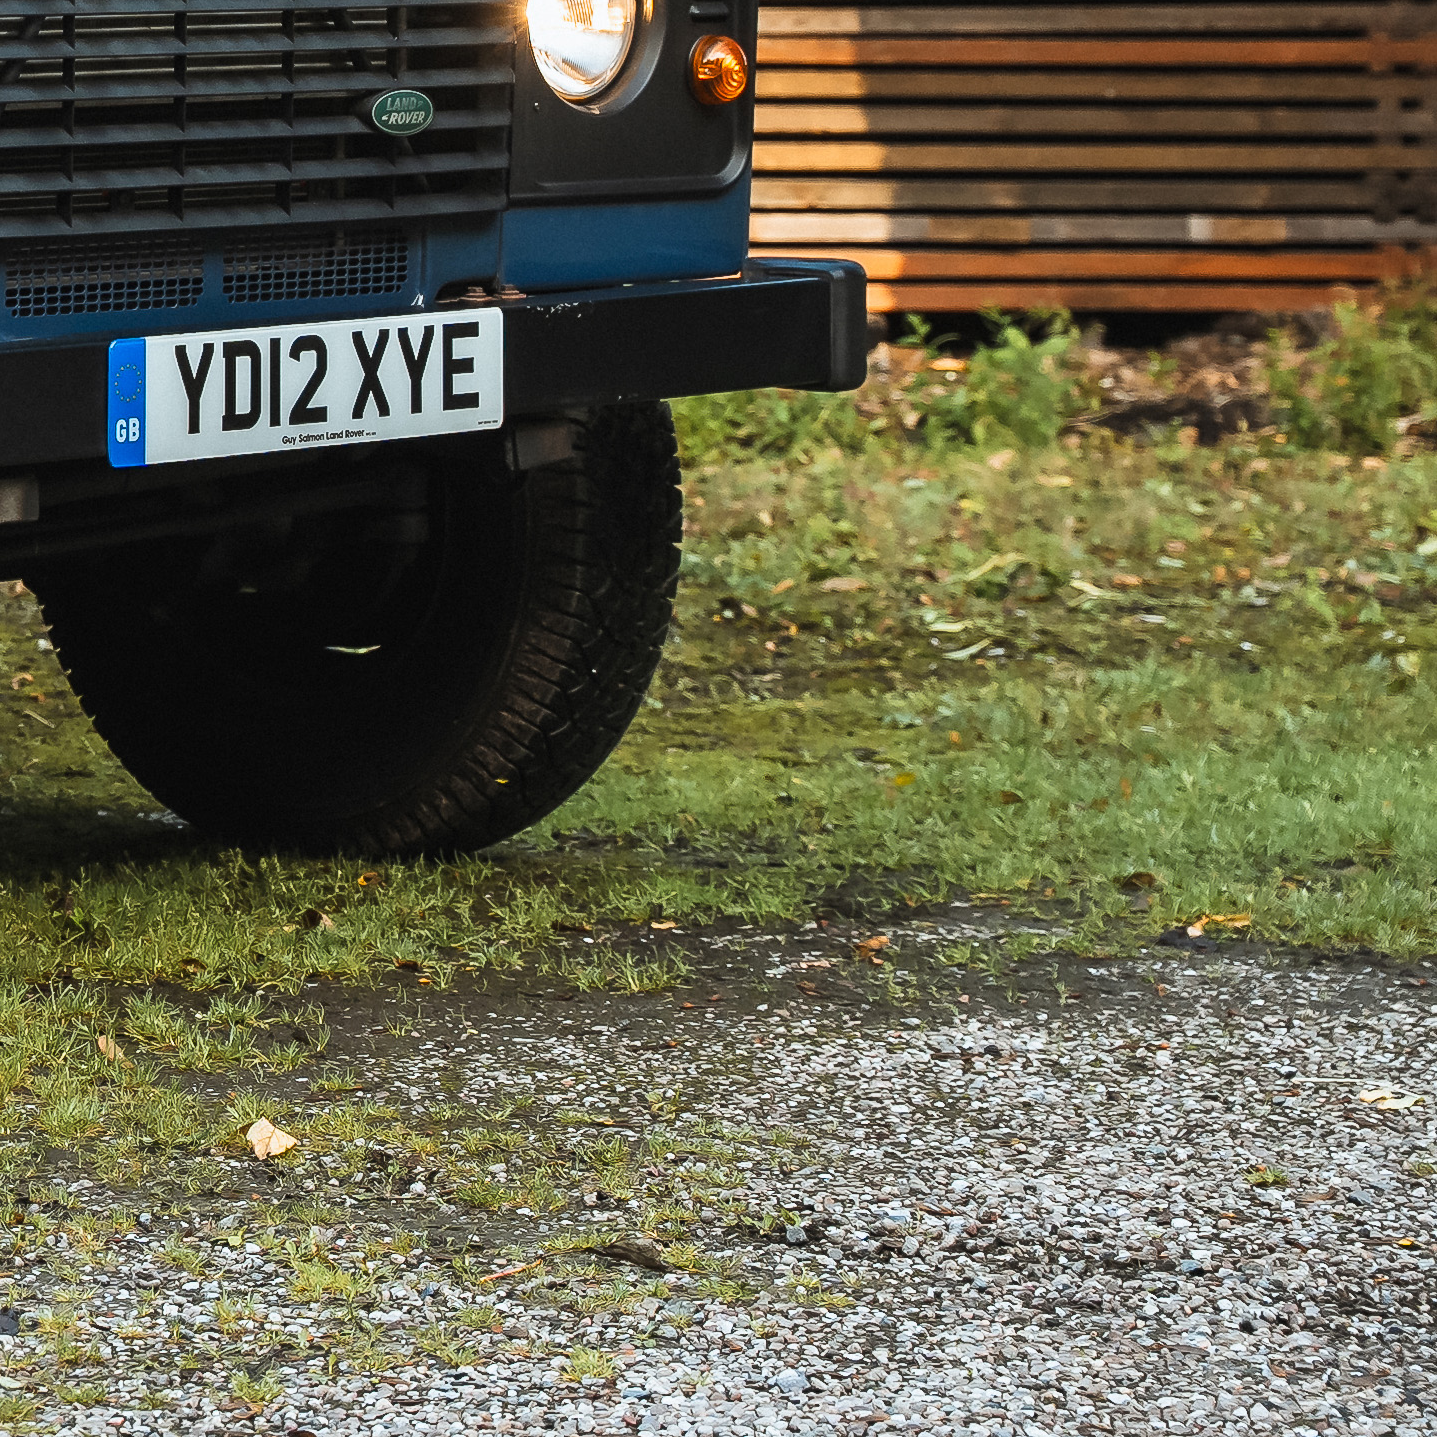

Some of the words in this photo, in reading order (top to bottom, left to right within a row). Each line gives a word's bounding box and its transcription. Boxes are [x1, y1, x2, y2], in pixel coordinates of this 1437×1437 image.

[386, 97, 417, 110] LAND
[388, 111, 425, 124] ROVER
[174, 334, 328, 435] YD12
[352, 321, 480, 420] XYE
[115, 417, 140, 443] GB
[282, 436, 297, 445] Guy
[298, 433, 324, 443] Salmon
[326, 430, 344, 440] Land
[345, 429, 365, 439] Rover
